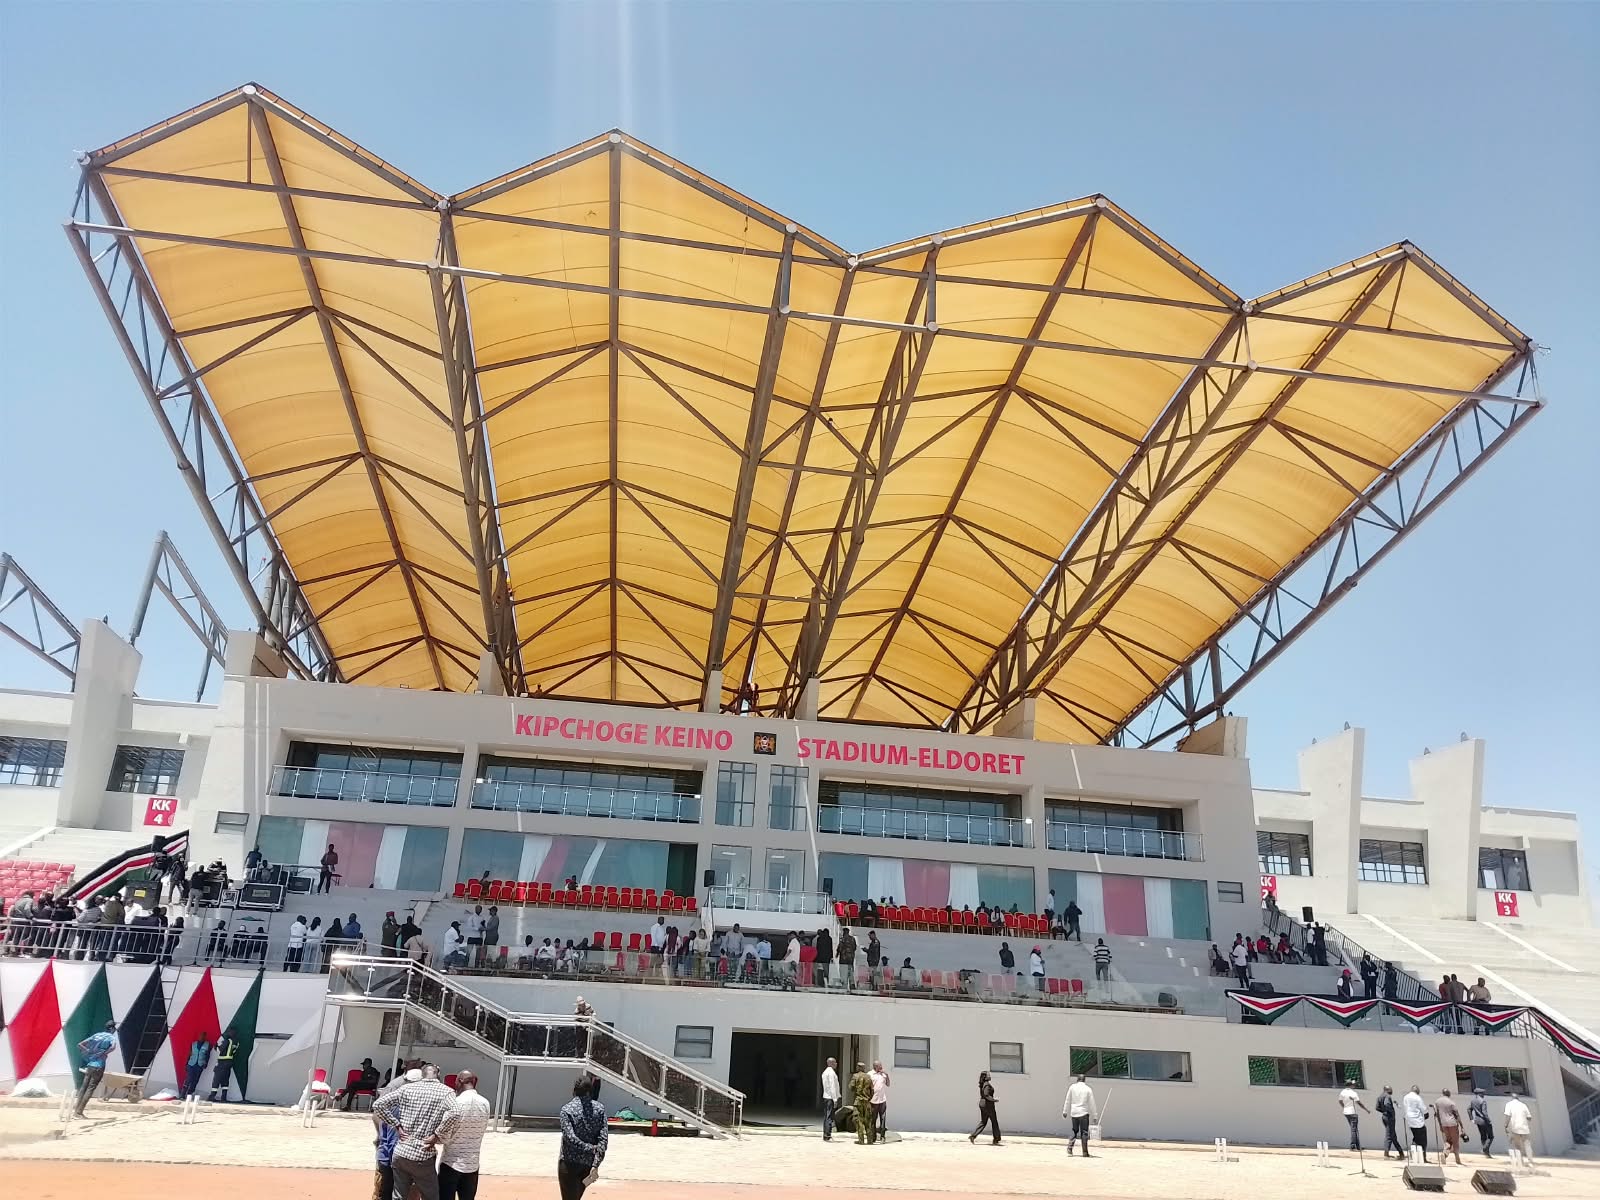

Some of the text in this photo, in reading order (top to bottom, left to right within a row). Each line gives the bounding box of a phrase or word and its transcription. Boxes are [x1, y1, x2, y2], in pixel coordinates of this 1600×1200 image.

[515, 714, 733, 751] KIPCHOGE KEINO
[797, 738, 1025, 775] STADIUM-ELDORET
[151, 800, 172, 811] KK
[153, 813, 163, 825] 4
[1498, 892, 1514, 903] KK
[1503, 905, 1511, 915] 3
